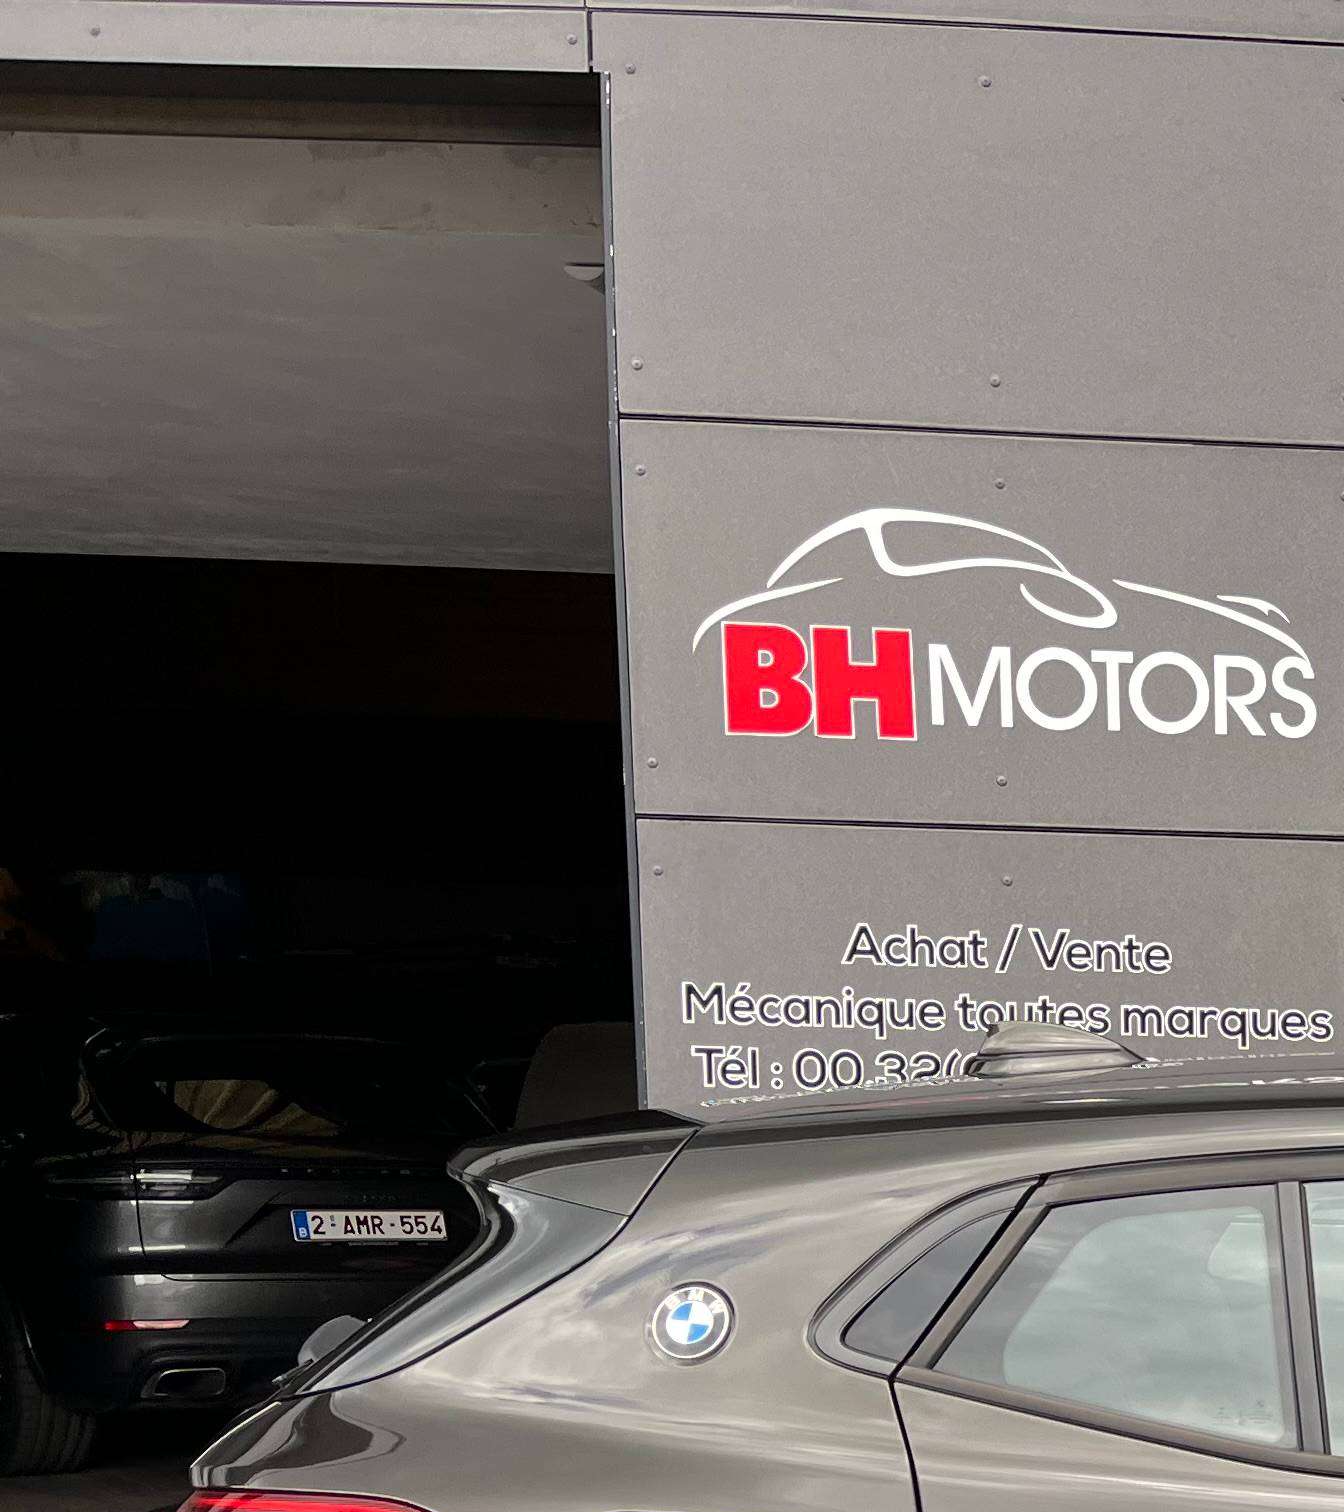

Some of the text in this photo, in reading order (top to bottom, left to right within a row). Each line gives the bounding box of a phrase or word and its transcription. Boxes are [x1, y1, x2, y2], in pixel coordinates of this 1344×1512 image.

[721, 621, 1317, 741] BH MOTORS
[842, 923, 1173, 974] Achat / Vente
[681, 981, 945, 1037] Mécanique
[1120, 1002, 1334, 1047] marques
[691, 1045, 760, 1089] Tél
